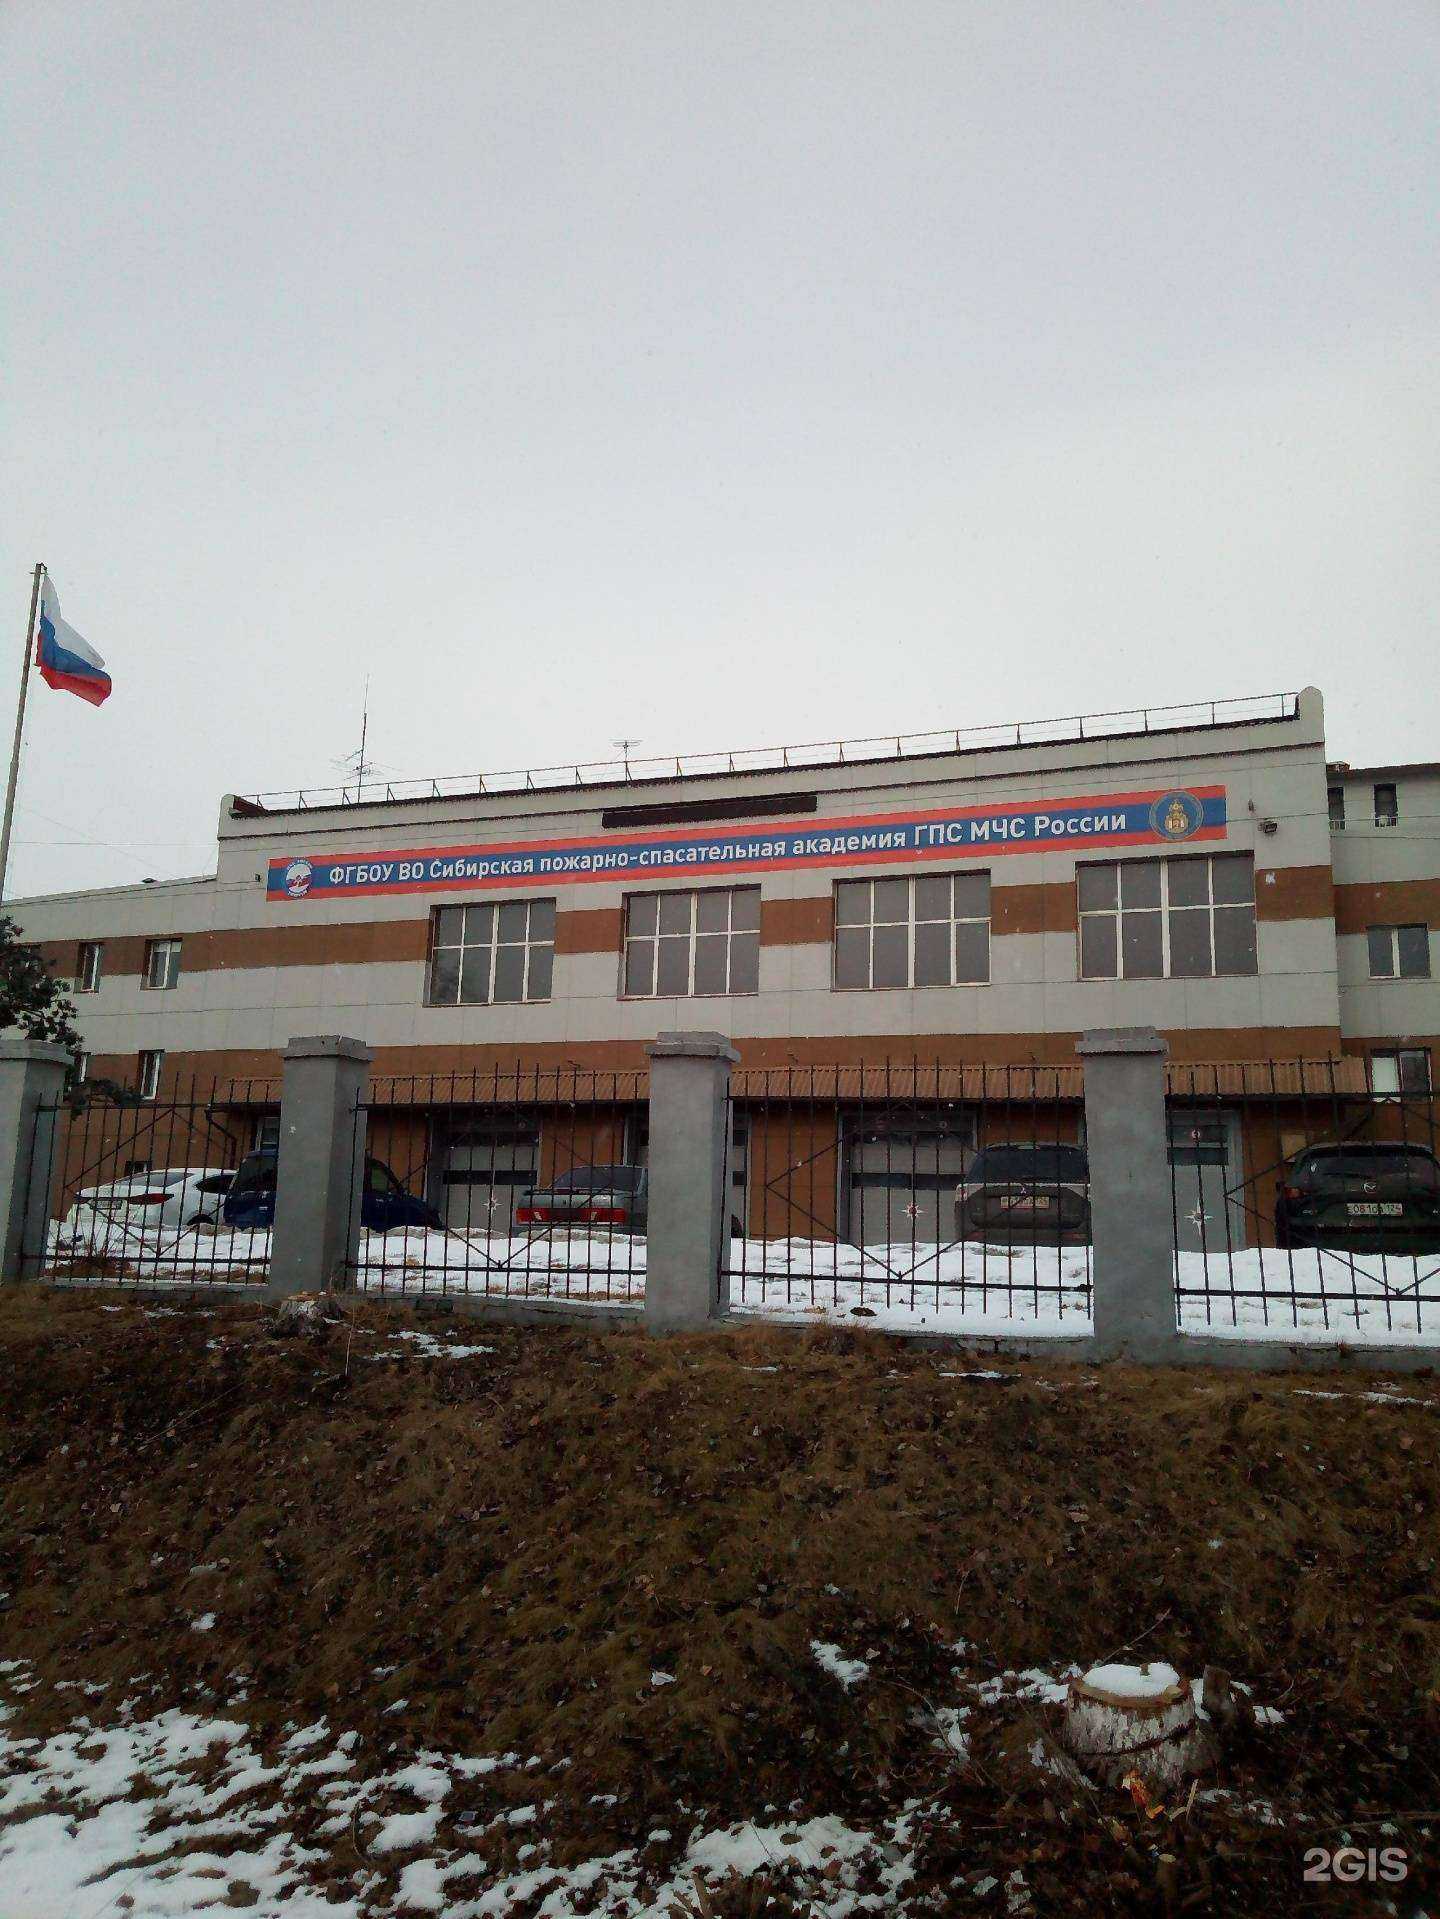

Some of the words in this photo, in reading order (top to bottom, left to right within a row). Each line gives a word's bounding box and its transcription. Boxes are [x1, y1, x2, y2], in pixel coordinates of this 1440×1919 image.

[329, 863, 394, 885] ФГБОУ
[399, 862, 424, 880] ВО
[430, 858, 534, 880] Сибирская
[540, 841, 786, 872] пожарно-спасательная
[792, 831, 906, 855] академия
[914, 823, 962, 846] ГПС
[971, 817, 1026, 841] МЧС
[1034, 814, 1126, 837] России
